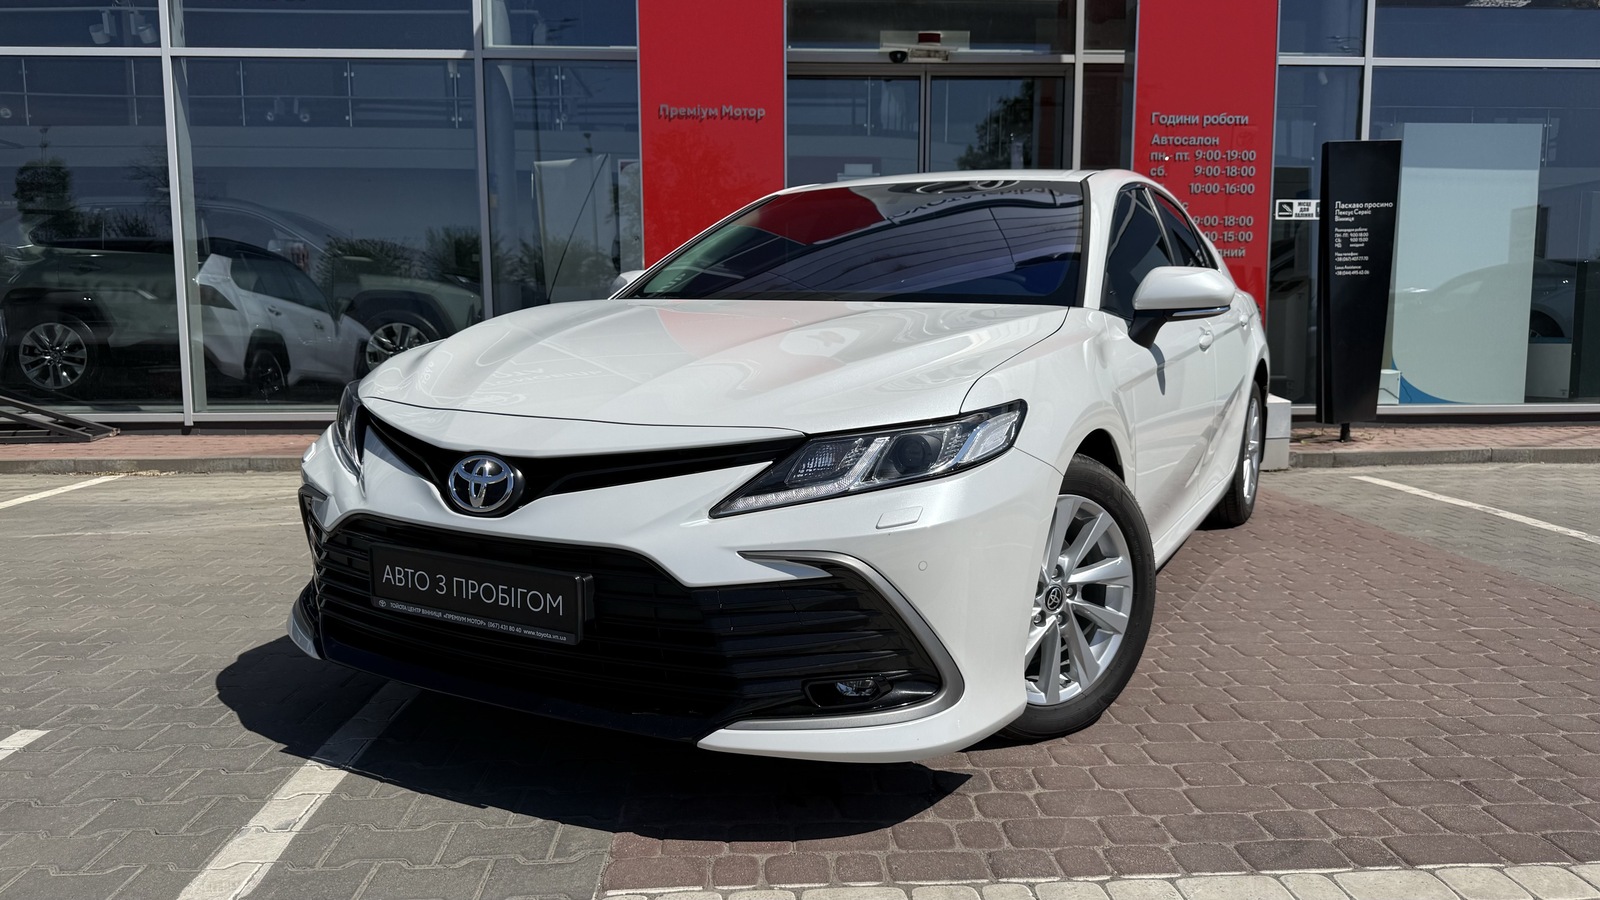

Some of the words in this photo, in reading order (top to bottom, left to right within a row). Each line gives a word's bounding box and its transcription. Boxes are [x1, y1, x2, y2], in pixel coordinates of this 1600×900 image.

[659, 104, 718, 119] Преміум
[721, 104, 766, 119] Мотор
[1151, 112, 1199, 126] Години
[1203, 112, 1249, 127] роботи
[1151, 134, 1219, 145] Автосалон
[1335, 201, 1364, 209] Ласкаво
[382, 564, 430, 591] АВТО
[453, 577, 563, 616] ПРОБІГОМ
[407, 605, 421, 613] ЦЕНТР
